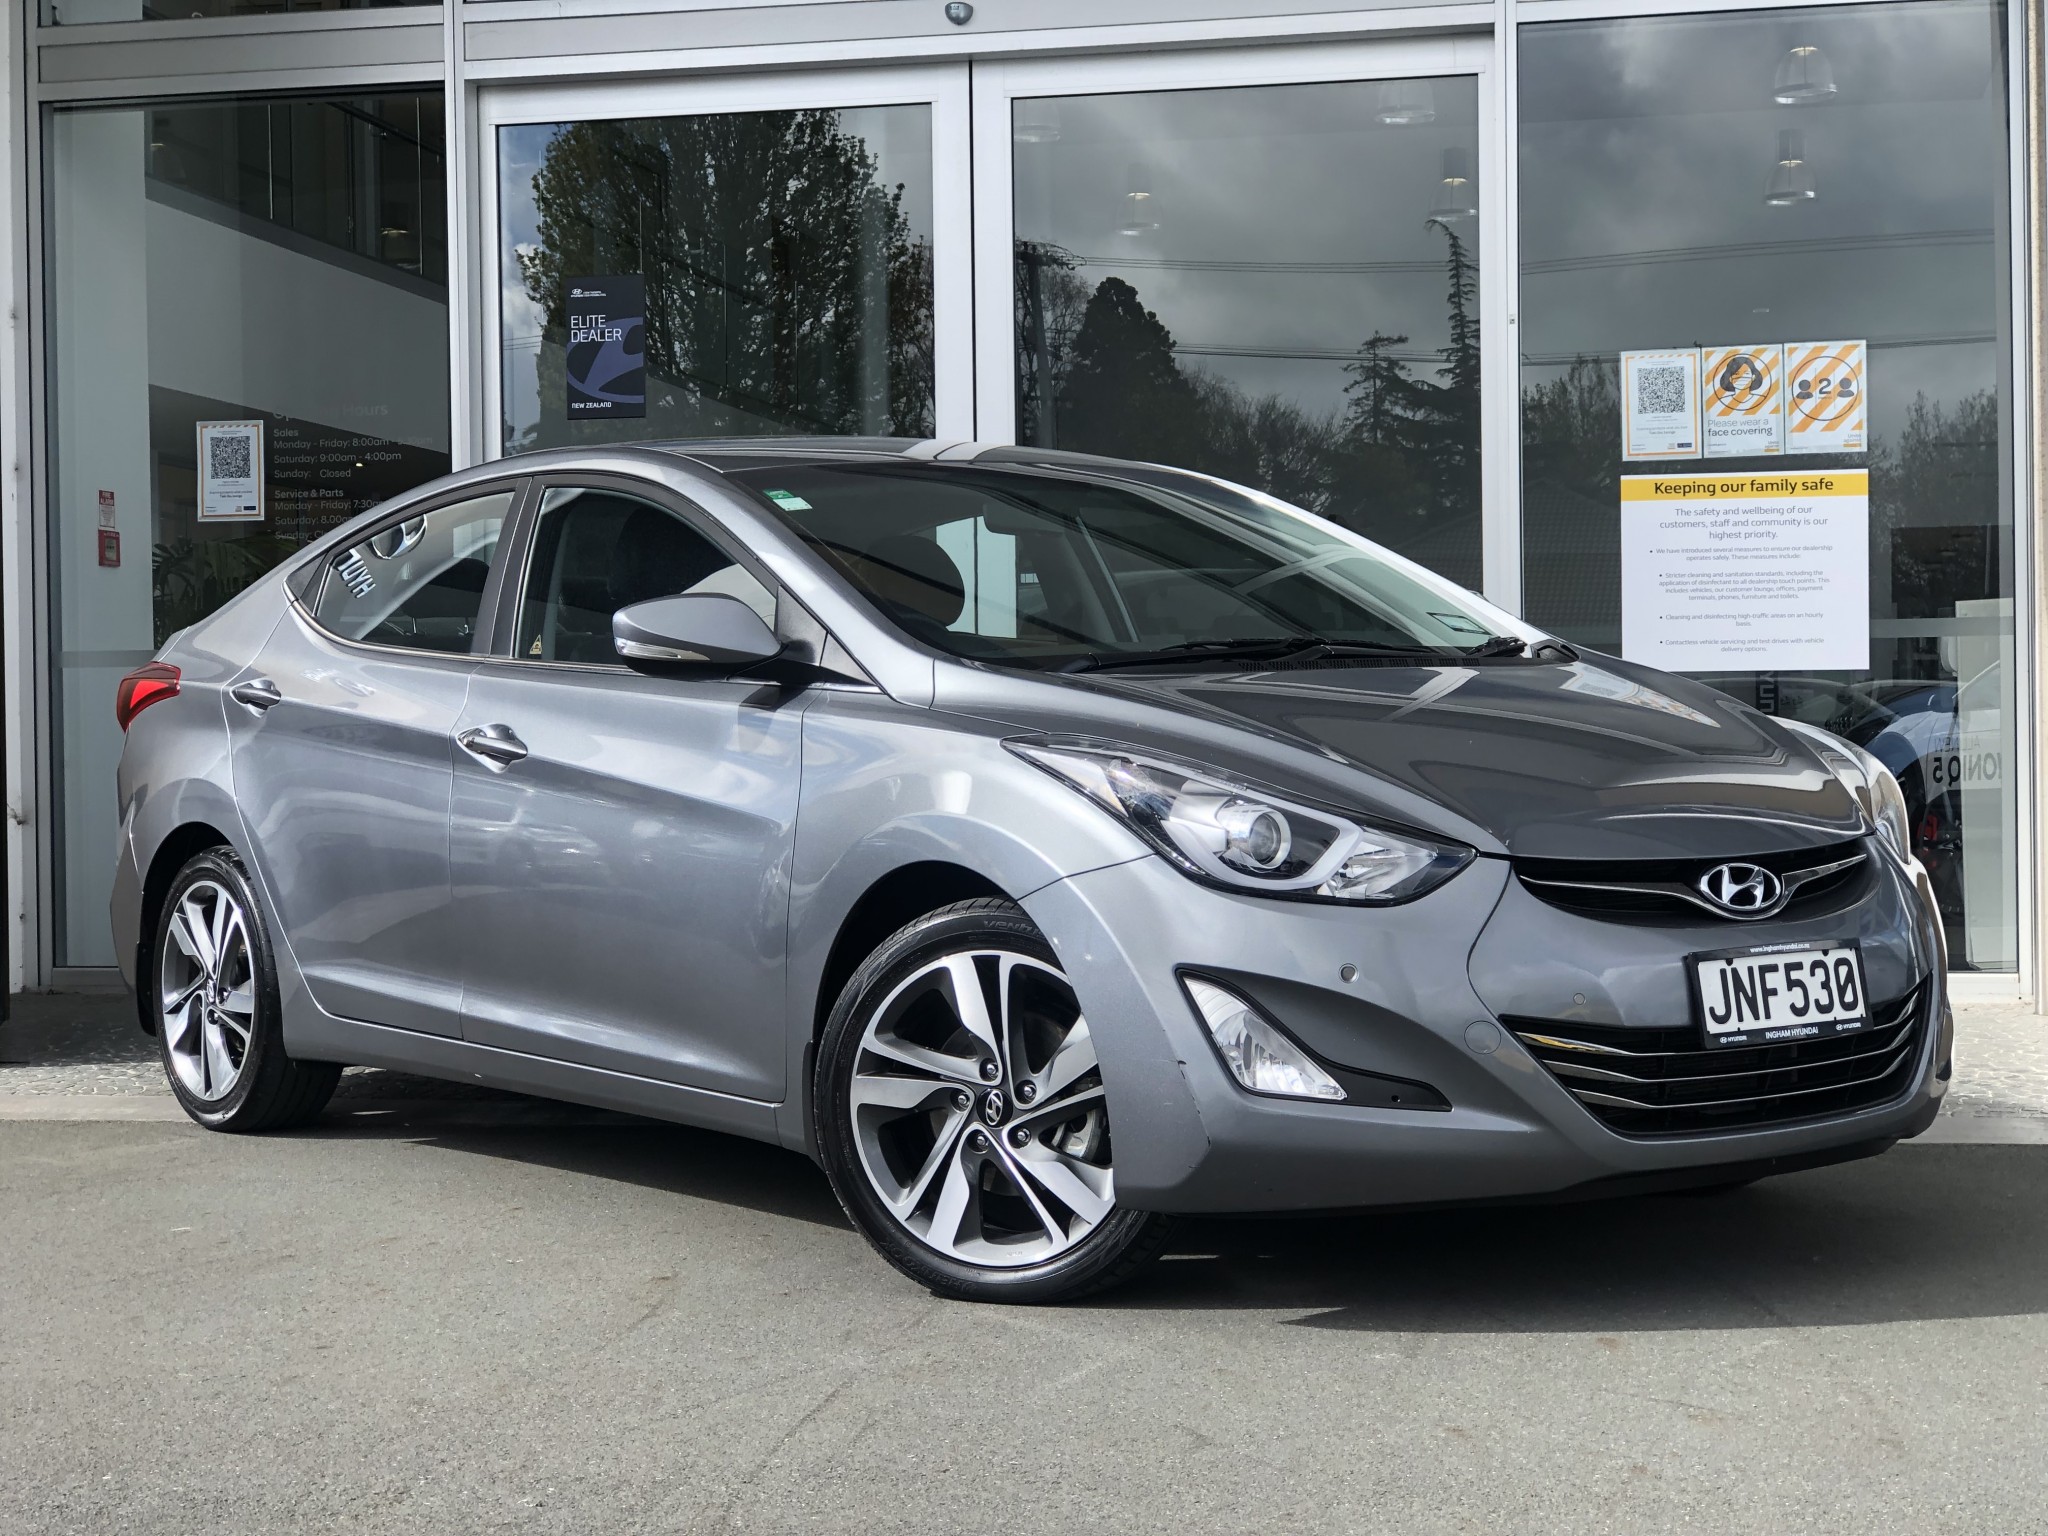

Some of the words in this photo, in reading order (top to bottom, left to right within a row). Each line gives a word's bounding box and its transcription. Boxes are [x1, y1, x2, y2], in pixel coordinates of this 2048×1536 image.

[571, 315, 606, 328] ELITE
[571, 329, 622, 342] DEALER
[1818, 377, 1832, 394] 2
[343, 403, 389, 416] Hours
[1707, 419, 1737, 428] Please
[273, 428, 298, 437] Sales
[1708, 428, 1729, 436] face
[1730, 426, 1773, 436] covering
[274, 440, 311, 450] Monday
[319, 438, 351, 449] Friday:
[352, 438, 389, 447] 8:00am
[274, 454, 317, 465] Saturday:
[320, 453, 356, 462] 9:00am
[365, 452, 402, 462] 4:00pm
[274, 469, 311, 480] Sunday:
[320, 468, 351, 478] Closed
[1654, 482, 1716, 496] Keeping
[1720, 482, 1747, 493] our
[1750, 479, 1798, 494] family
[1801, 478, 1834, 491] safe
[274, 490, 309, 498] Service
[311, 490, 318, 498] &
[319, 489, 344, 497] Parts
[274, 501, 312, 511] Monday
[320, 500, 351, 510] Friday:
[1675, 508, 1692, 516] The
[1694, 508, 1720, 518] safety
[1722, 507, 1740, 516] and
[1742, 506, 1784, 516] wellbeing
[1786, 506, 1796, 514] of
[1797, 506, 1813, 514] our
[275, 516, 318, 526] Saturday:
[1659, 520, 1708, 529] customers,
[1710, 519, 1730, 528] staff
[1751, 518, 1802, 528] community
[1803, 518, 1811, 526] is
[1812, 518, 1828, 526] our
[275, 531, 312, 541] Sunday:
[1709, 530, 1742, 540] highest
[1744, 530, 1778, 540] priority.
[1768, 592, 1779, 600] and
[1738, 612, 1770, 620] high-traffic
[1708, 957, 1859, 1025] JNF530
[1765, 1030, 1790, 1040] INGHAM
[1791, 1026, 1819, 1038] HYUNDAI
